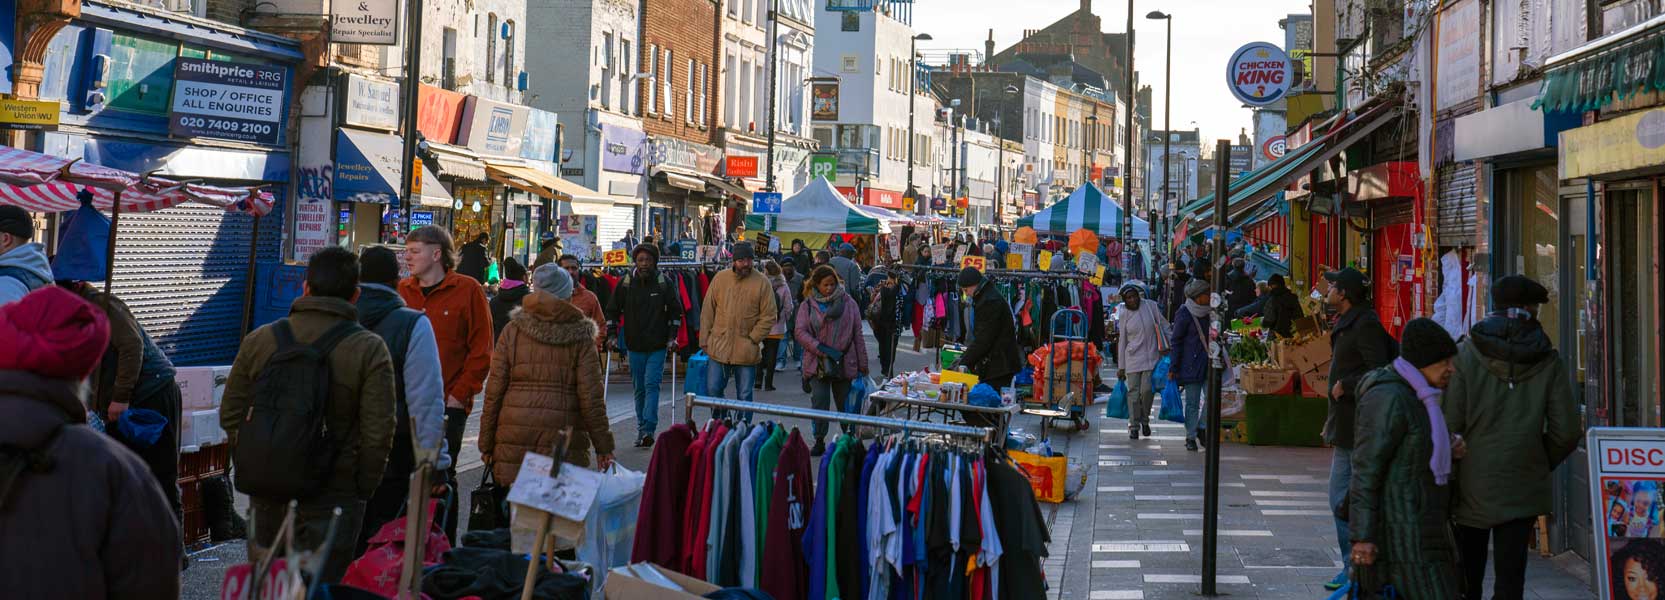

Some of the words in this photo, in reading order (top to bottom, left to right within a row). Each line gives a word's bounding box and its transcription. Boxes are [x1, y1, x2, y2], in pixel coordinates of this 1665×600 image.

[358, 1, 369, 11] &
[334, 14, 392, 29] Jewellery
[333, 28, 356, 37] Repair
[1240, 61, 1285, 70] CHICKEN
[181, 62, 254, 78] smithprice
[255, 70, 281, 81] RRG
[1237, 70, 1285, 85] KING
[184, 87, 217, 98] SHOP
[219, 90, 228, 100] /
[230, 91, 272, 104] OFFICE
[4, 103, 37, 112] Western
[182, 98, 205, 109] ALL
[208, 101, 272, 116] ENQUIRIES
[180, 116, 205, 128] 020
[208, 119, 239, 131] 7409
[241, 122, 271, 135] 2100
[338, 163, 371, 173] Jewellery
[731, 159, 753, 168] Rishi
[339, 172, 369, 181] Repairs
[606, 251, 625, 264] £5
[682, 250, 694, 260] £8
[1607, 448, 1663, 466] DISC
